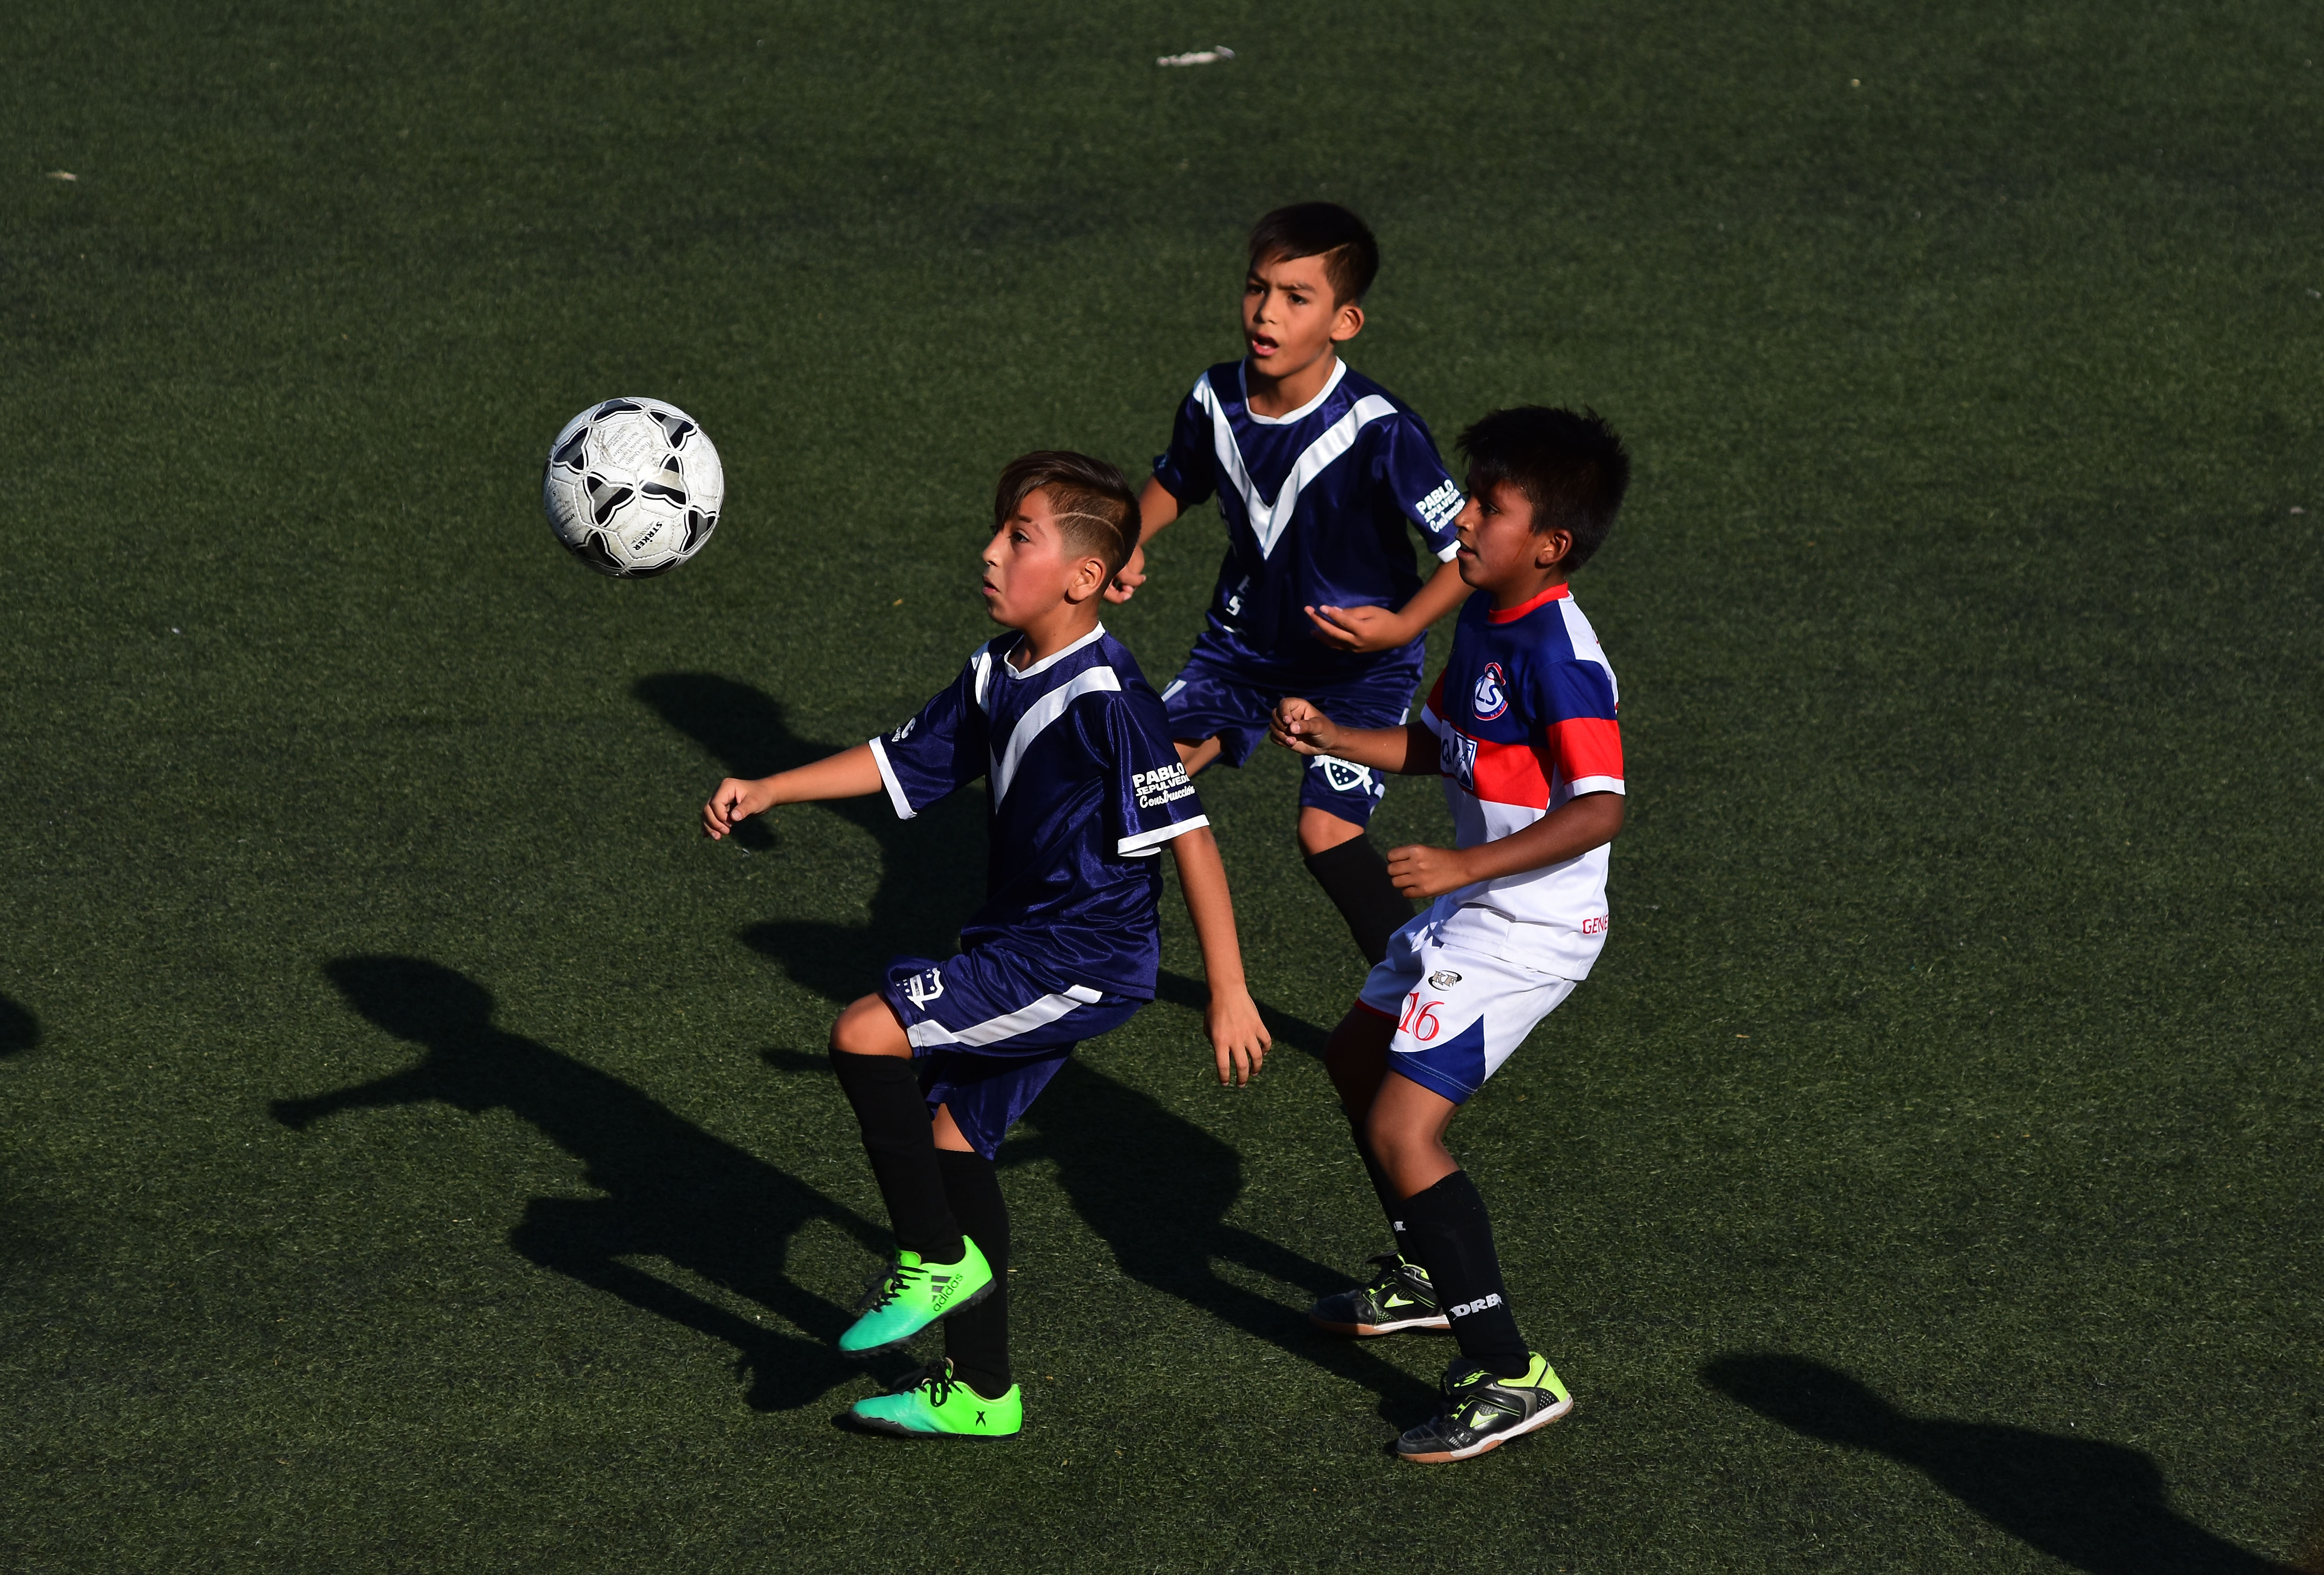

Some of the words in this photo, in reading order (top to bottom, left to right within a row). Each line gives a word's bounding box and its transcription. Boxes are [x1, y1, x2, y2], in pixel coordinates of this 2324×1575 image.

[612, 441, 627, 456] Bladder
[617, 449, 631, 463] Leather
[639, 441, 650, 451] High
[626, 450, 640, 466] Quality
[1415, 479, 1454, 515] PABLO
[633, 521, 663, 550] STRIKER
[1132, 762, 1185, 788] PABLO
[1136, 774, 1190, 796] SEPULVEDA
[1139, 785, 1195, 808] Construcción
[1582, 914, 1608, 934] GENE
[1398, 992, 1445, 1041] 16
[933, 1274, 963, 1312] adidas
